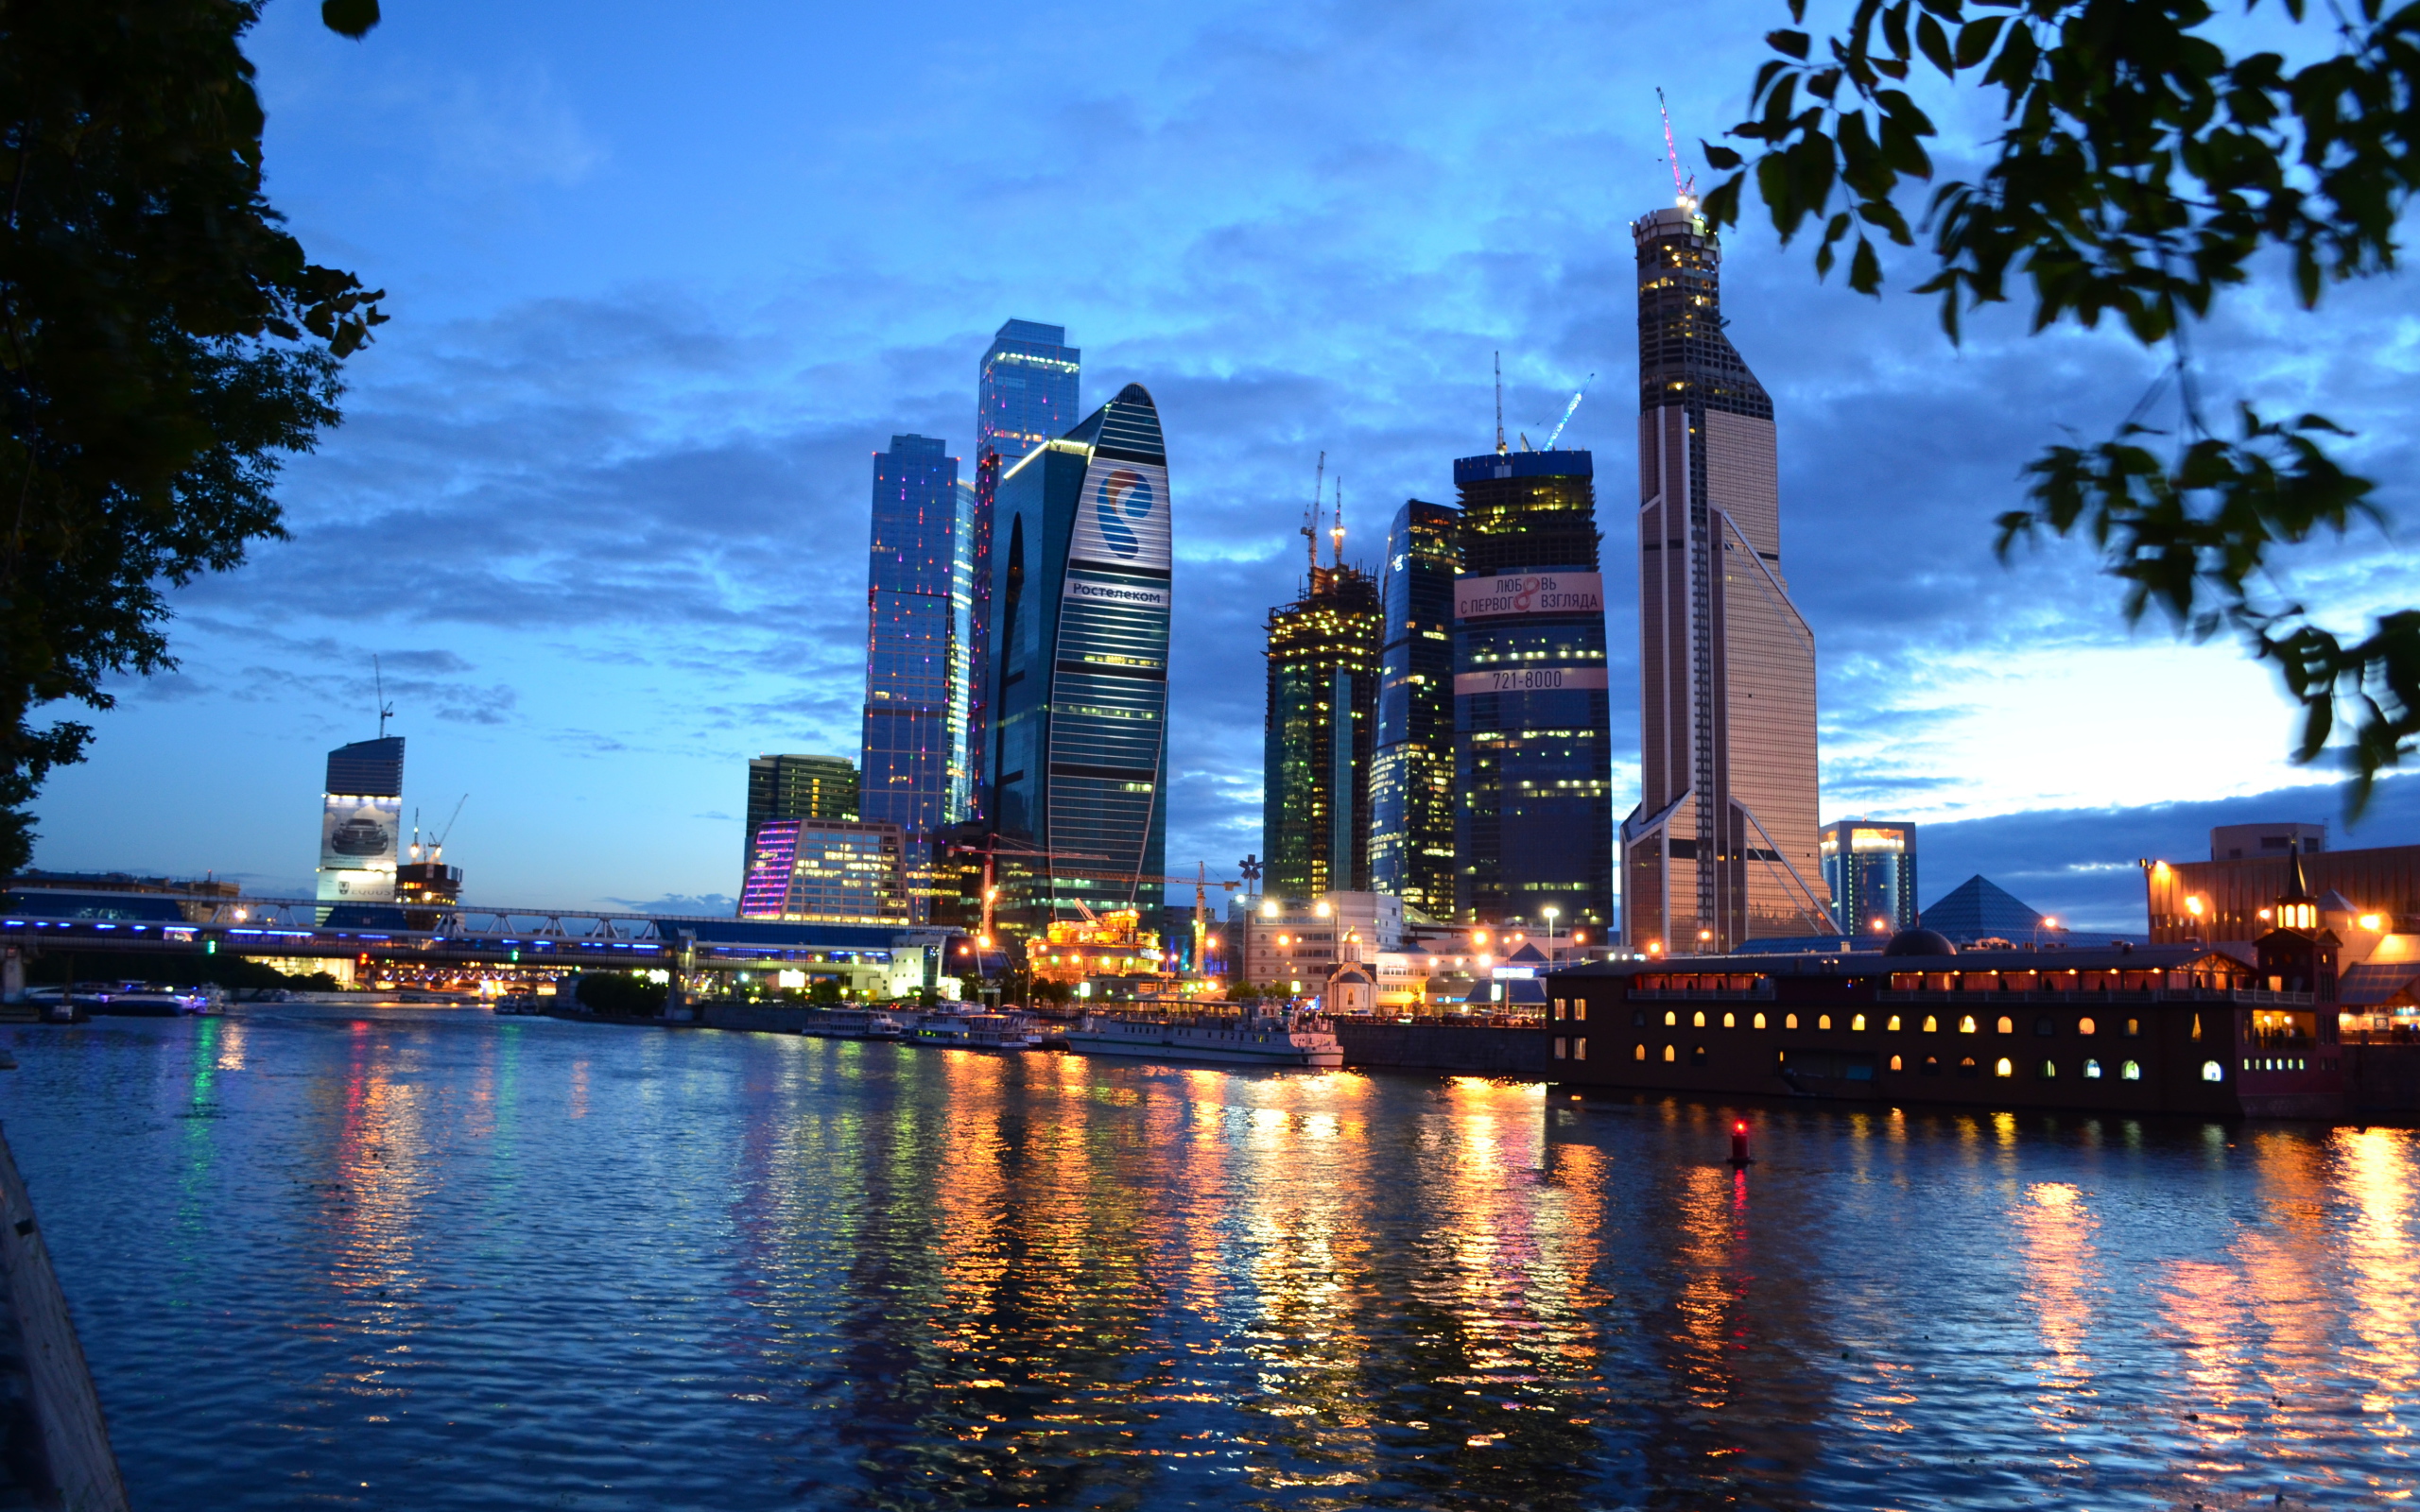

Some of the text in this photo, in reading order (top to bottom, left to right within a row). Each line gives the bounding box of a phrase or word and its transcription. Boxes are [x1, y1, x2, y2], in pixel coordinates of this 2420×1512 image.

[1073, 583, 1161, 603] Ростелеком
[1461, 600, 1468, 613] С
[1541, 593, 1598, 610] ВЗГЛЯДА
[1493, 670, 1562, 689] 721-8000
